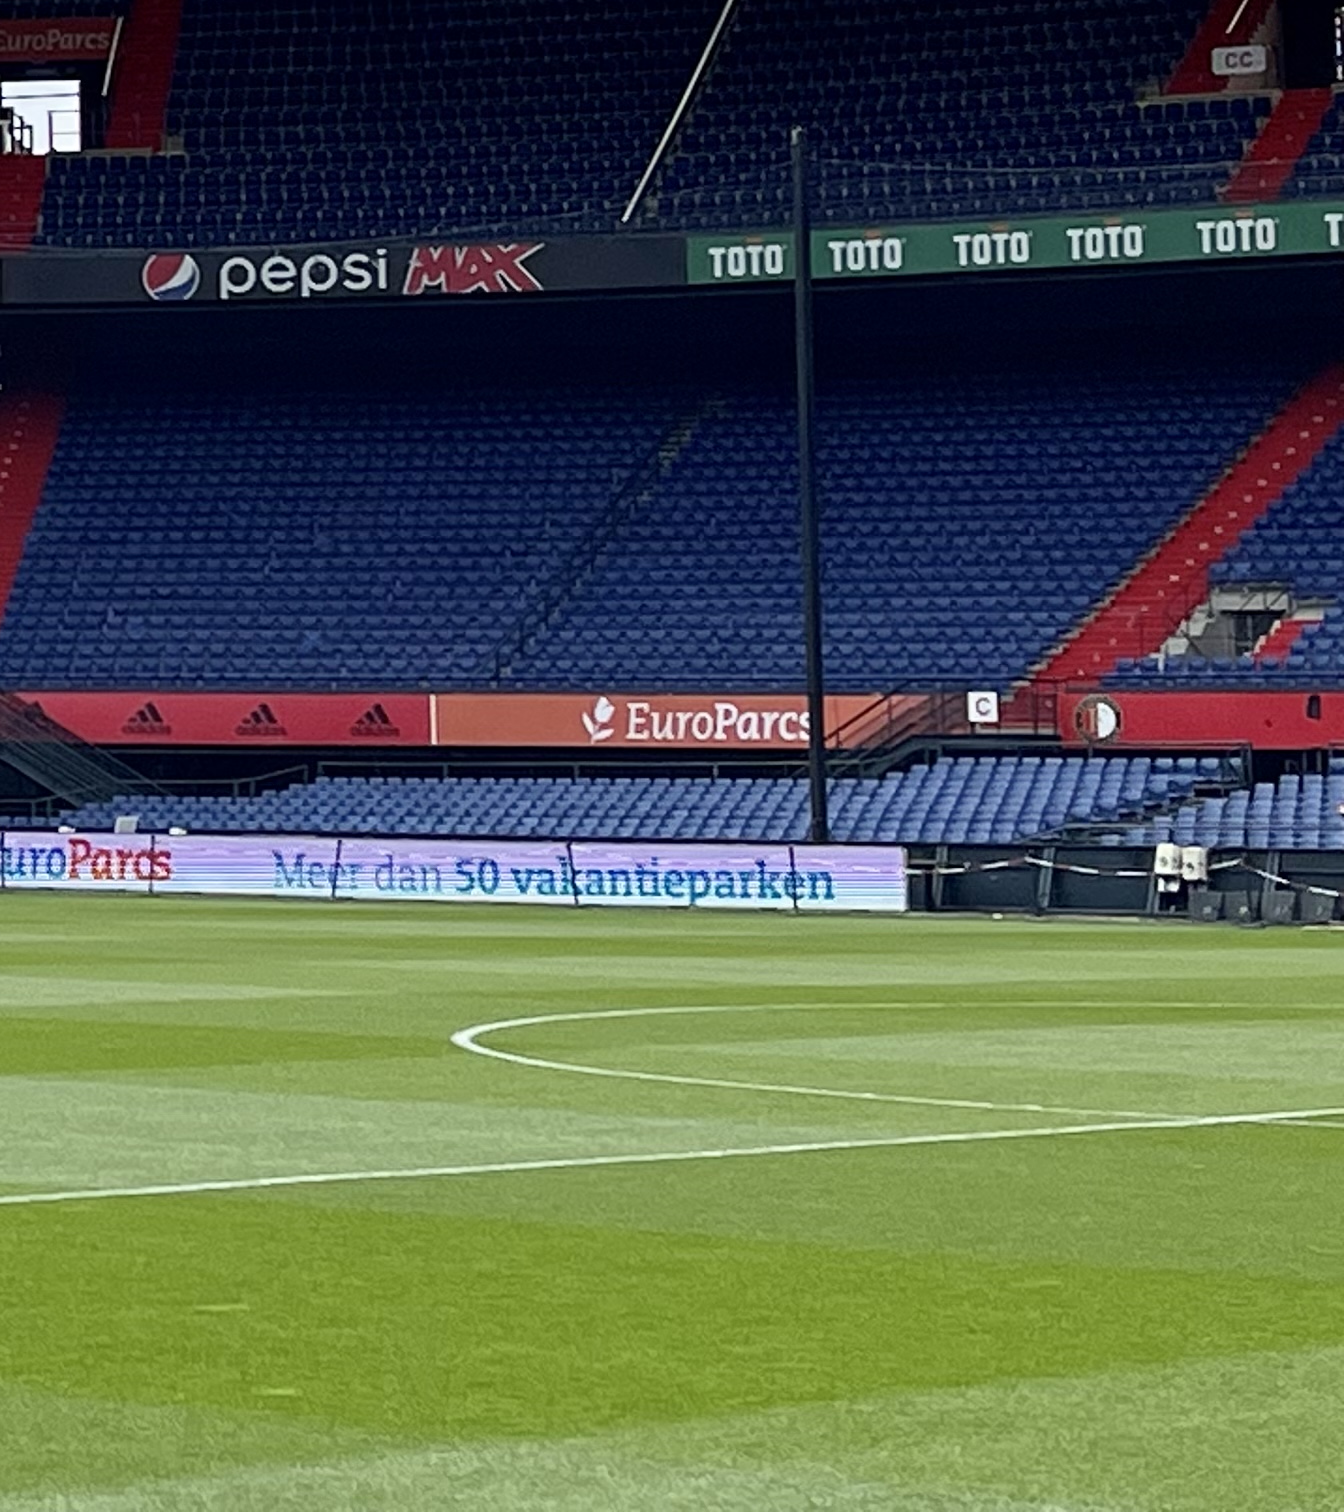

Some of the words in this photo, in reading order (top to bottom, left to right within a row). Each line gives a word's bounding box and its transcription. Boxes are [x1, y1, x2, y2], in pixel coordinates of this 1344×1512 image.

[1224, 51, 1254, 69] CC
[952, 231, 1031, 267] TOTO
[1066, 224, 1144, 261] TOTO
[1196, 217, 1276, 254] TOTO
[219, 248, 388, 299] pepsi
[403, 242, 546, 294] MAX
[708, 243, 784, 278] TOTO
[828, 237, 903, 273] TOTO
[975, 697, 991, 716] C
[375, 854, 443, 892] dan
[455, 856, 502, 895] 50
[510, 856, 836, 908] vakantieparken
